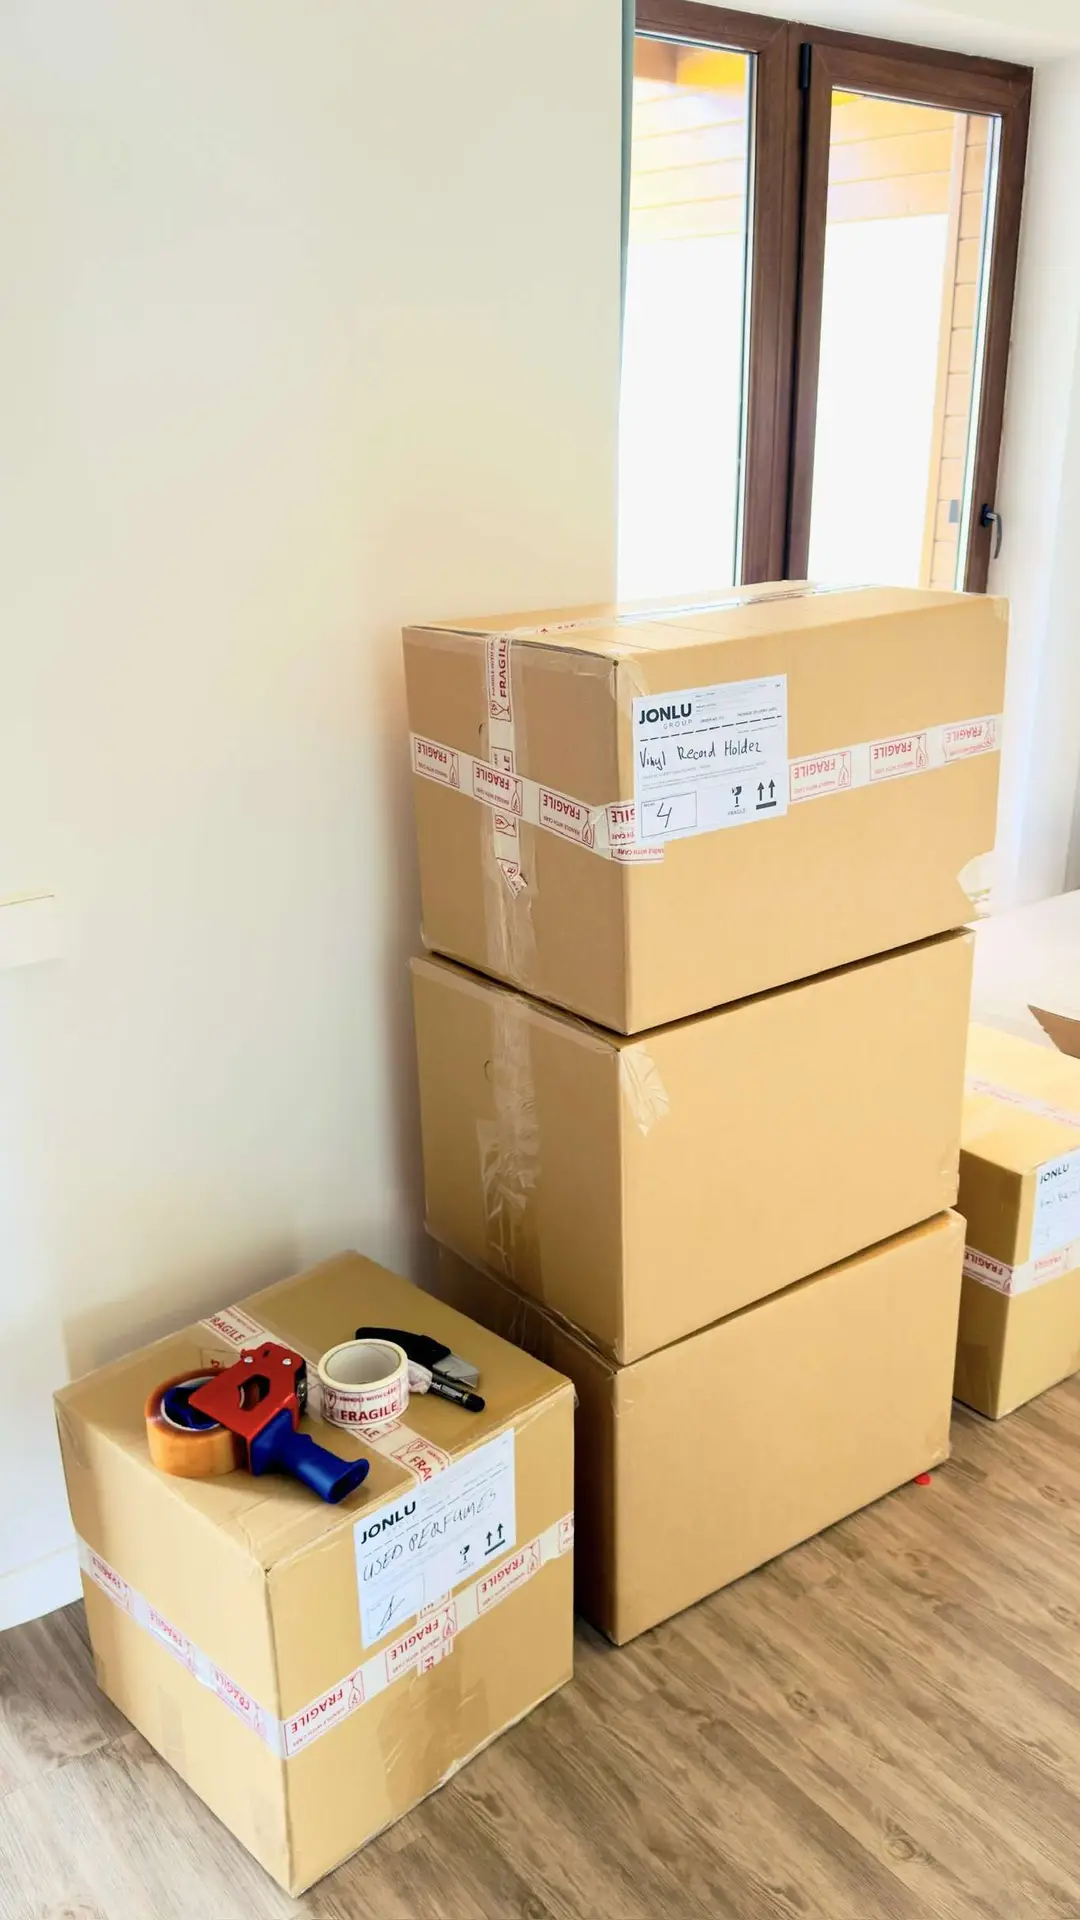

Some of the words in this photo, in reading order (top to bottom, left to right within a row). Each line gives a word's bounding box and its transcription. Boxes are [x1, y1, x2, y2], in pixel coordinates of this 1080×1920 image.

[498, 637, 506, 697] FRAGILE
[639, 703, 692, 725] JONLU
[663, 719, 693, 730] GROUP
[945, 725, 982, 742] FRAGILE
[416, 742, 447, 763] FRAGILE
[640, 747, 666, 771] Vinyl
[677, 741, 716, 760] Record
[873, 741, 912, 759] FRAGILE
[475, 767, 509, 790] FRAGILE
[793, 759, 835, 778] FRAGILE
[542, 793, 580, 820] FRAGILE
[657, 803, 672, 828] 4
[1040, 1164, 1070, 1184] JONLU
[340, 1401, 398, 1421] FRAGILE
[361, 1501, 416, 1544] JONLU
[363, 1544, 403, 1582] USED
[409, 1487, 497, 1551] PERFUMES
[479, 1555, 525, 1593] FRAGILE
[388, 1618, 440, 1661] FRAGILE
[288, 1688, 344, 1734] FRAGILE
